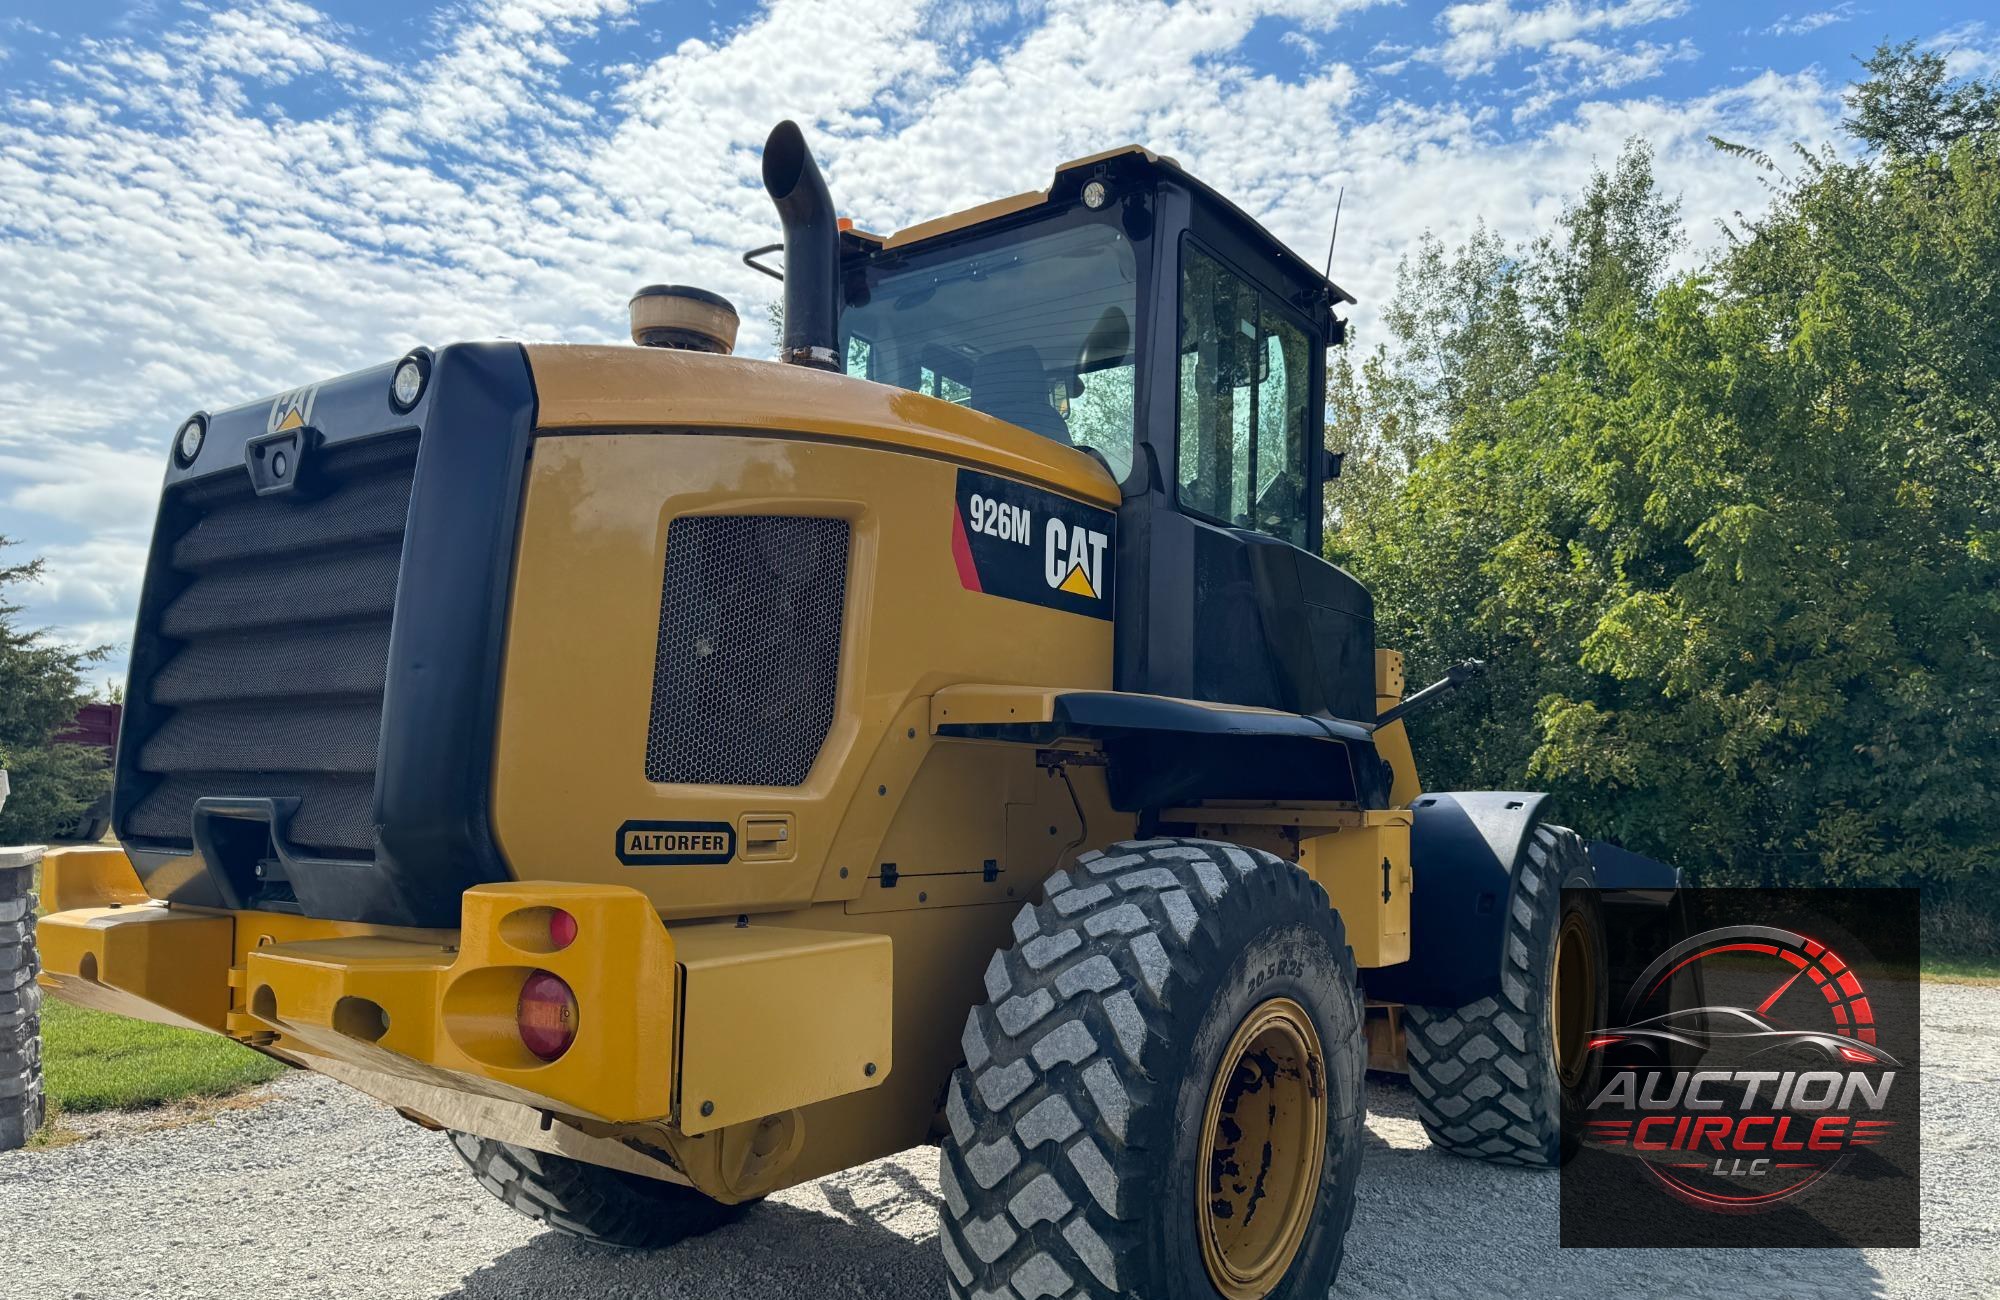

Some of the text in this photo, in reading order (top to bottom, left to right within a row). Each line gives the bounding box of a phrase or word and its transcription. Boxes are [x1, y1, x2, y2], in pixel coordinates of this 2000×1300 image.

[266, 382, 321, 433] CAT
[970, 493, 1108, 600] 926M CAT
[630, 834, 725, 851] ALTORFER
